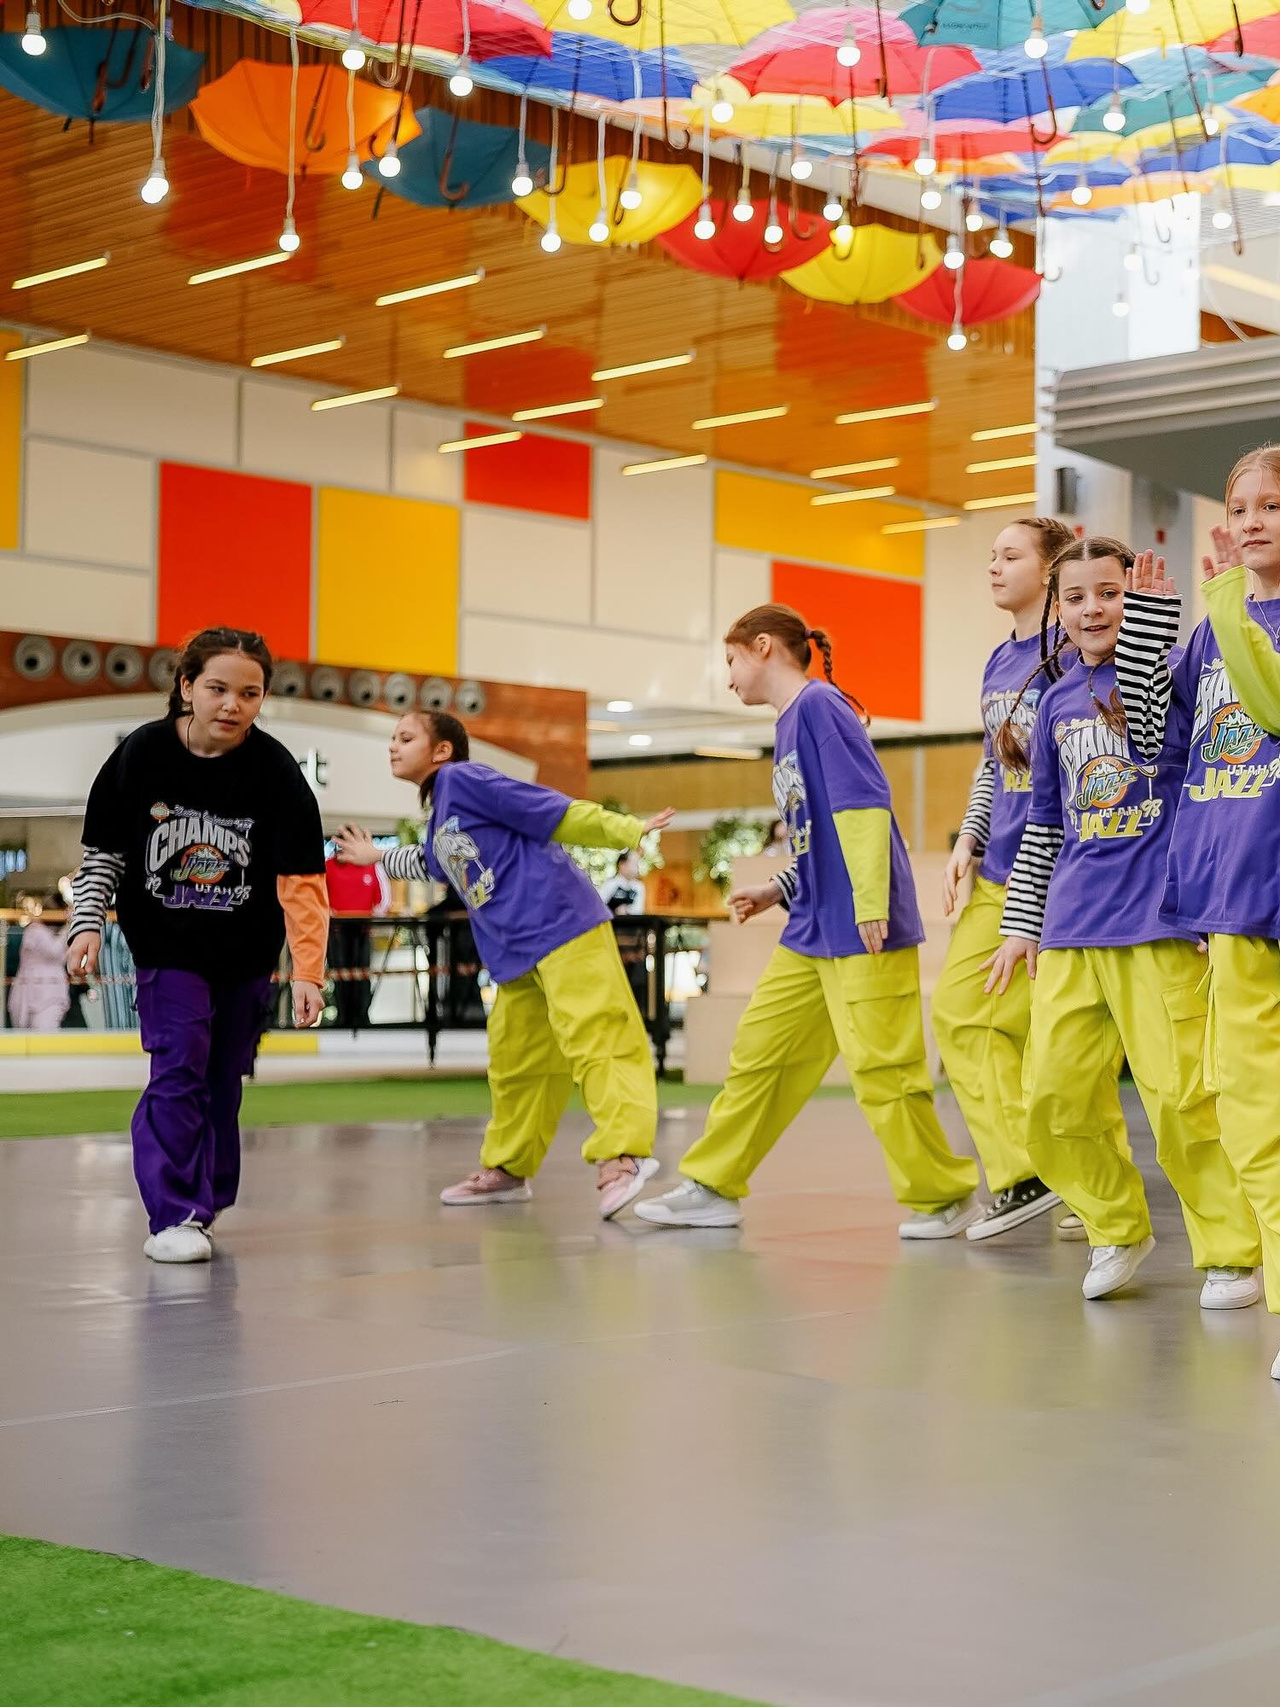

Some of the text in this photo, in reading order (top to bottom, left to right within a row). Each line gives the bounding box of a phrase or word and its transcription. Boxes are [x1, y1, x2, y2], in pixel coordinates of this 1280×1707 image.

[1227, 764, 1267, 775] UTAH
[1189, 767, 1270, 803] JAZZ
[1100, 799, 1163, 818] UTAH 98
[1079, 811, 1144, 843] JAZZ
[149, 816, 251, 872] CHAMPS
[195, 883, 232, 895] UTAH
[234, 885, 252, 900] 98
